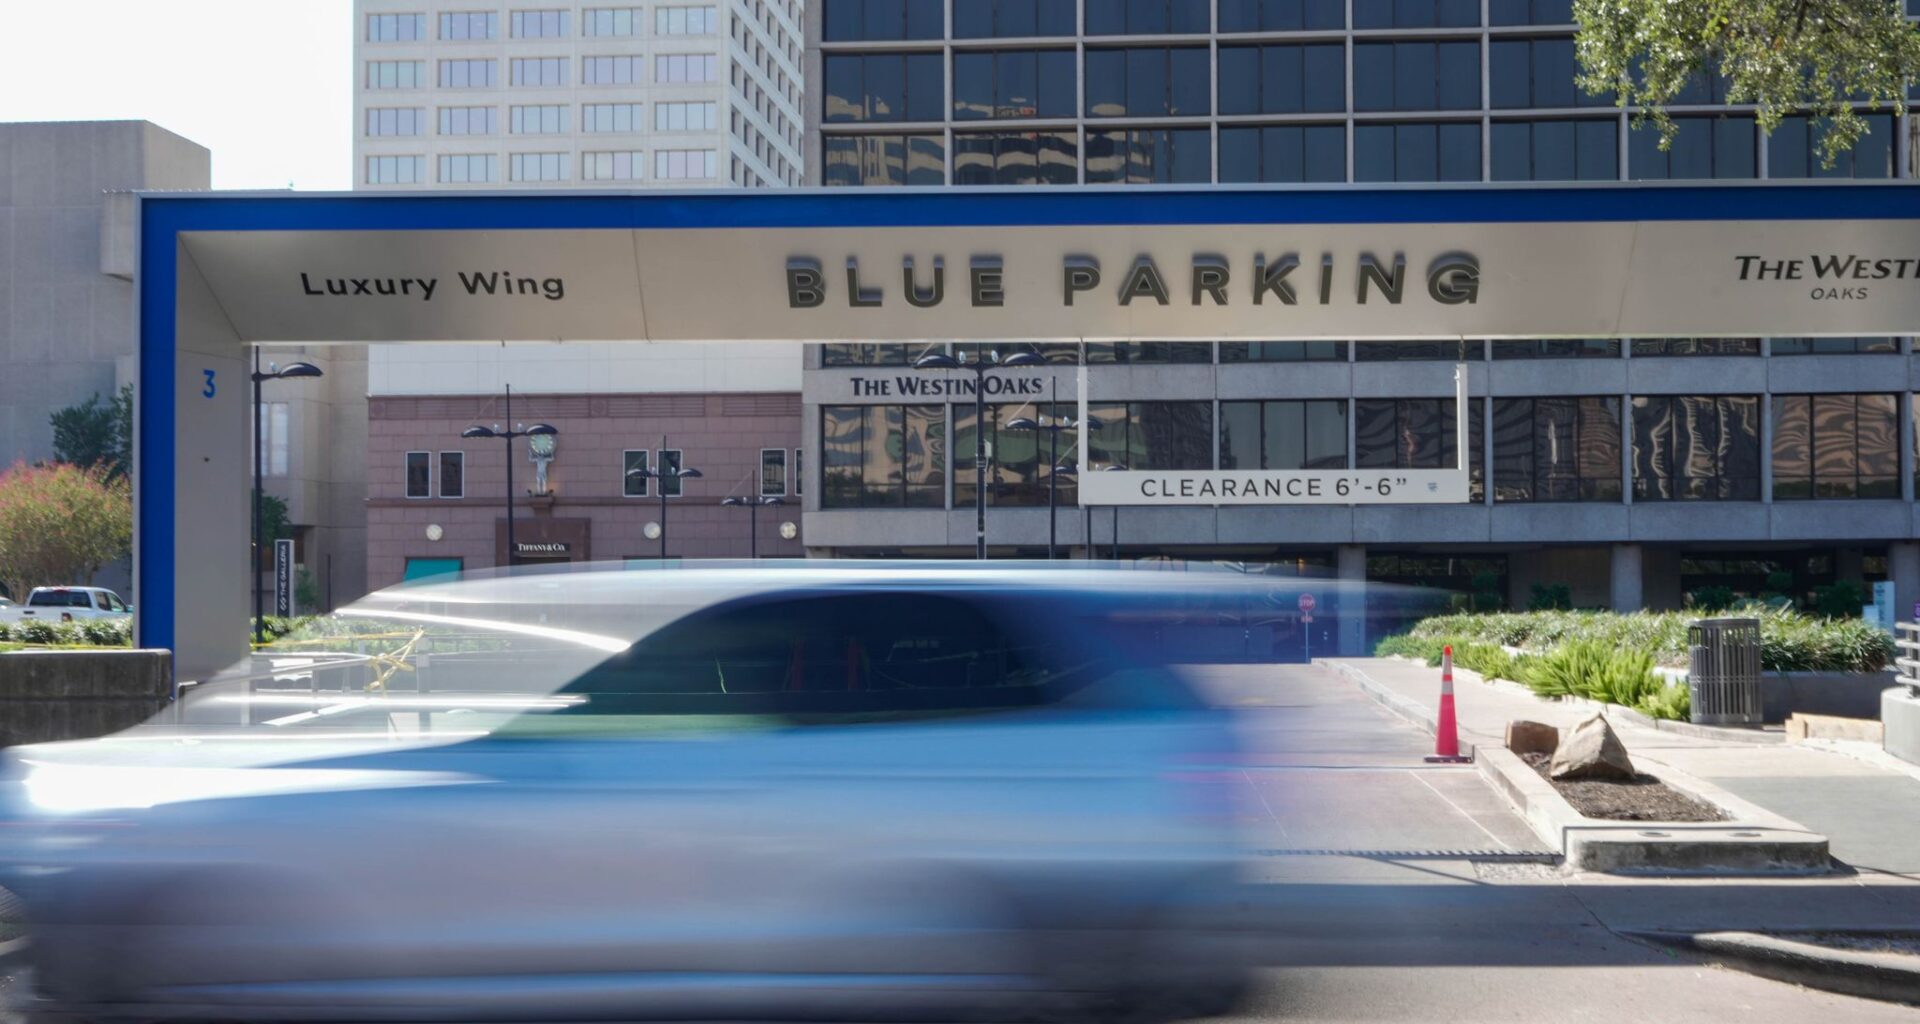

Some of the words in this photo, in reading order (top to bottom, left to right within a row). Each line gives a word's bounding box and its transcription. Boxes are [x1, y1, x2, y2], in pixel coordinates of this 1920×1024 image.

[785, 254, 1005, 309] BLUE
[1061, 251, 1482, 307] PARKING
[1734, 255, 1803, 281] THE
[300, 272, 437, 301] Luxury
[457, 271, 565, 300] Wing
[1810, 287, 1869, 300] OAKS
[203, 368, 216, 399] 3
[850, 377, 892, 397] THE
[896, 376, 977, 396] WESTIN
[983, 375, 1043, 395] OAKS
[1140, 478, 1323, 497] CLEARANCE
